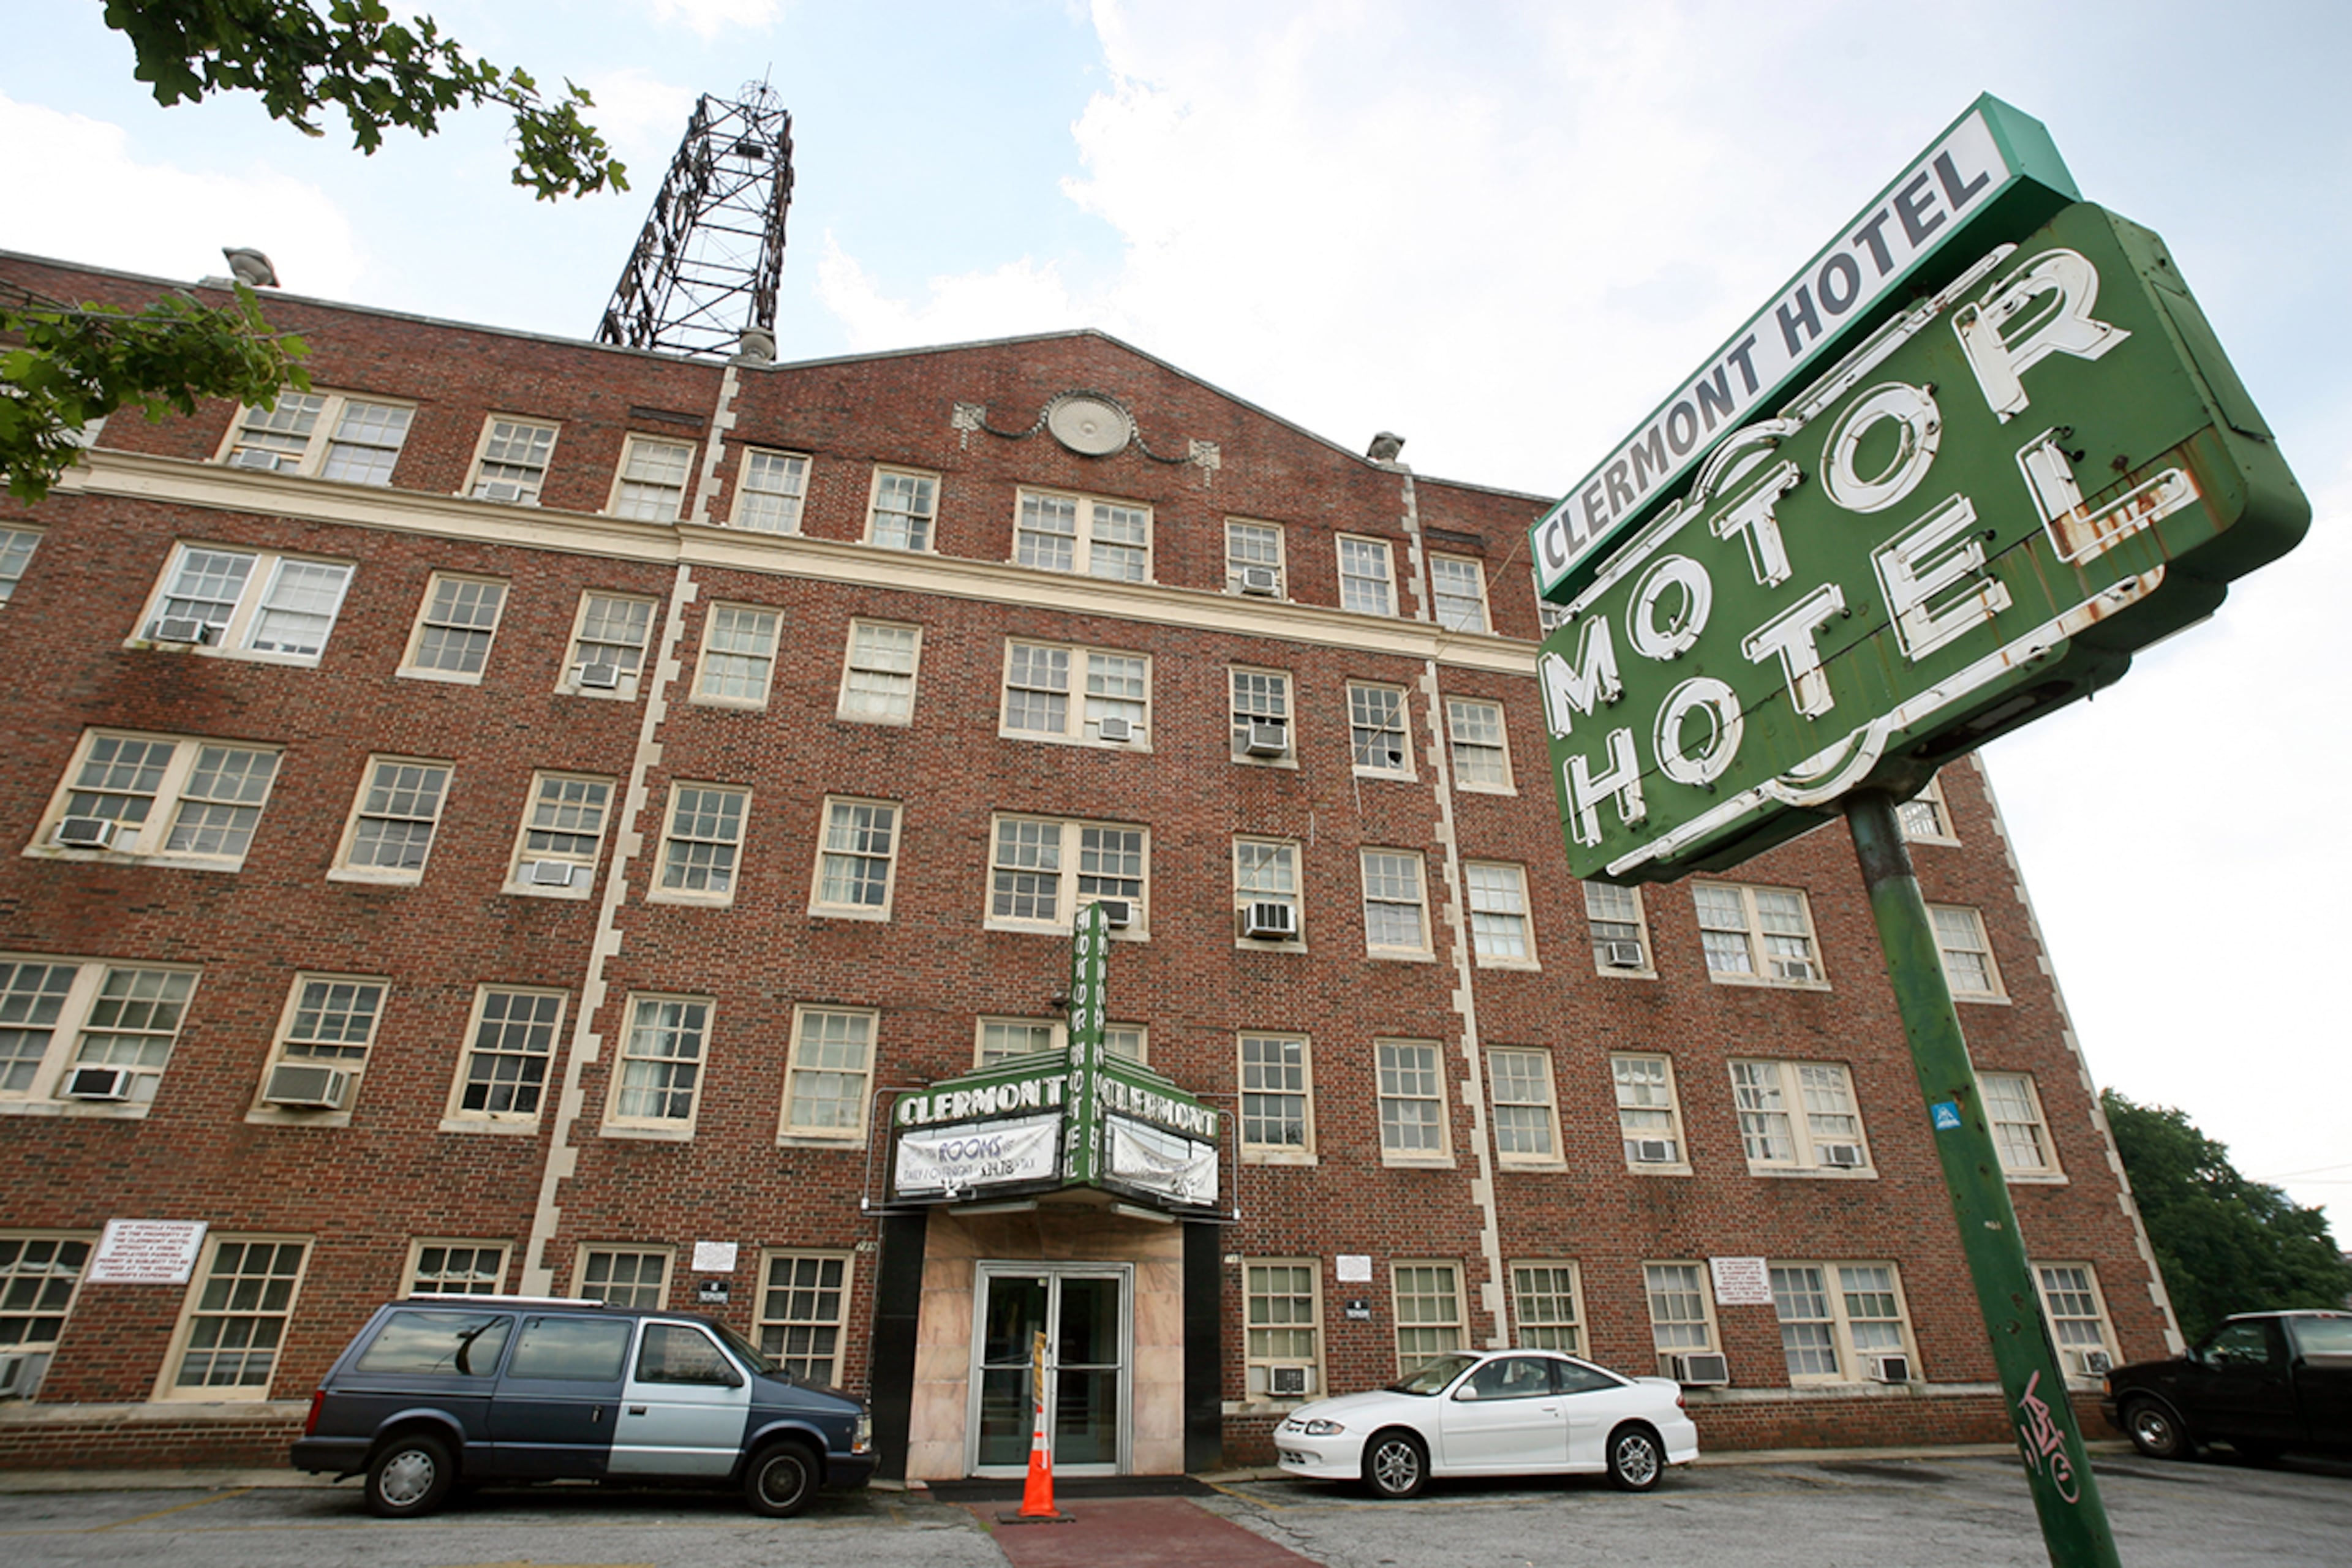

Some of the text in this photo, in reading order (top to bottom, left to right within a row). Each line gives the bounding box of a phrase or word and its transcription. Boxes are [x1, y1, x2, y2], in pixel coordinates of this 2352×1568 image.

[1544, 150, 1991, 570] CLERMONT HOTEL
[1538, 247, 2132, 740] MOTOR
[1563, 426, 2203, 848] HOTEL
[898, 1075, 1068, 1126] CLERMONT
[938, 1135, 1003, 1163] ROOMS
[1063, 1041, 1085, 1178] HOTEL
[1102, 1077, 1218, 1137] CLERMONT
